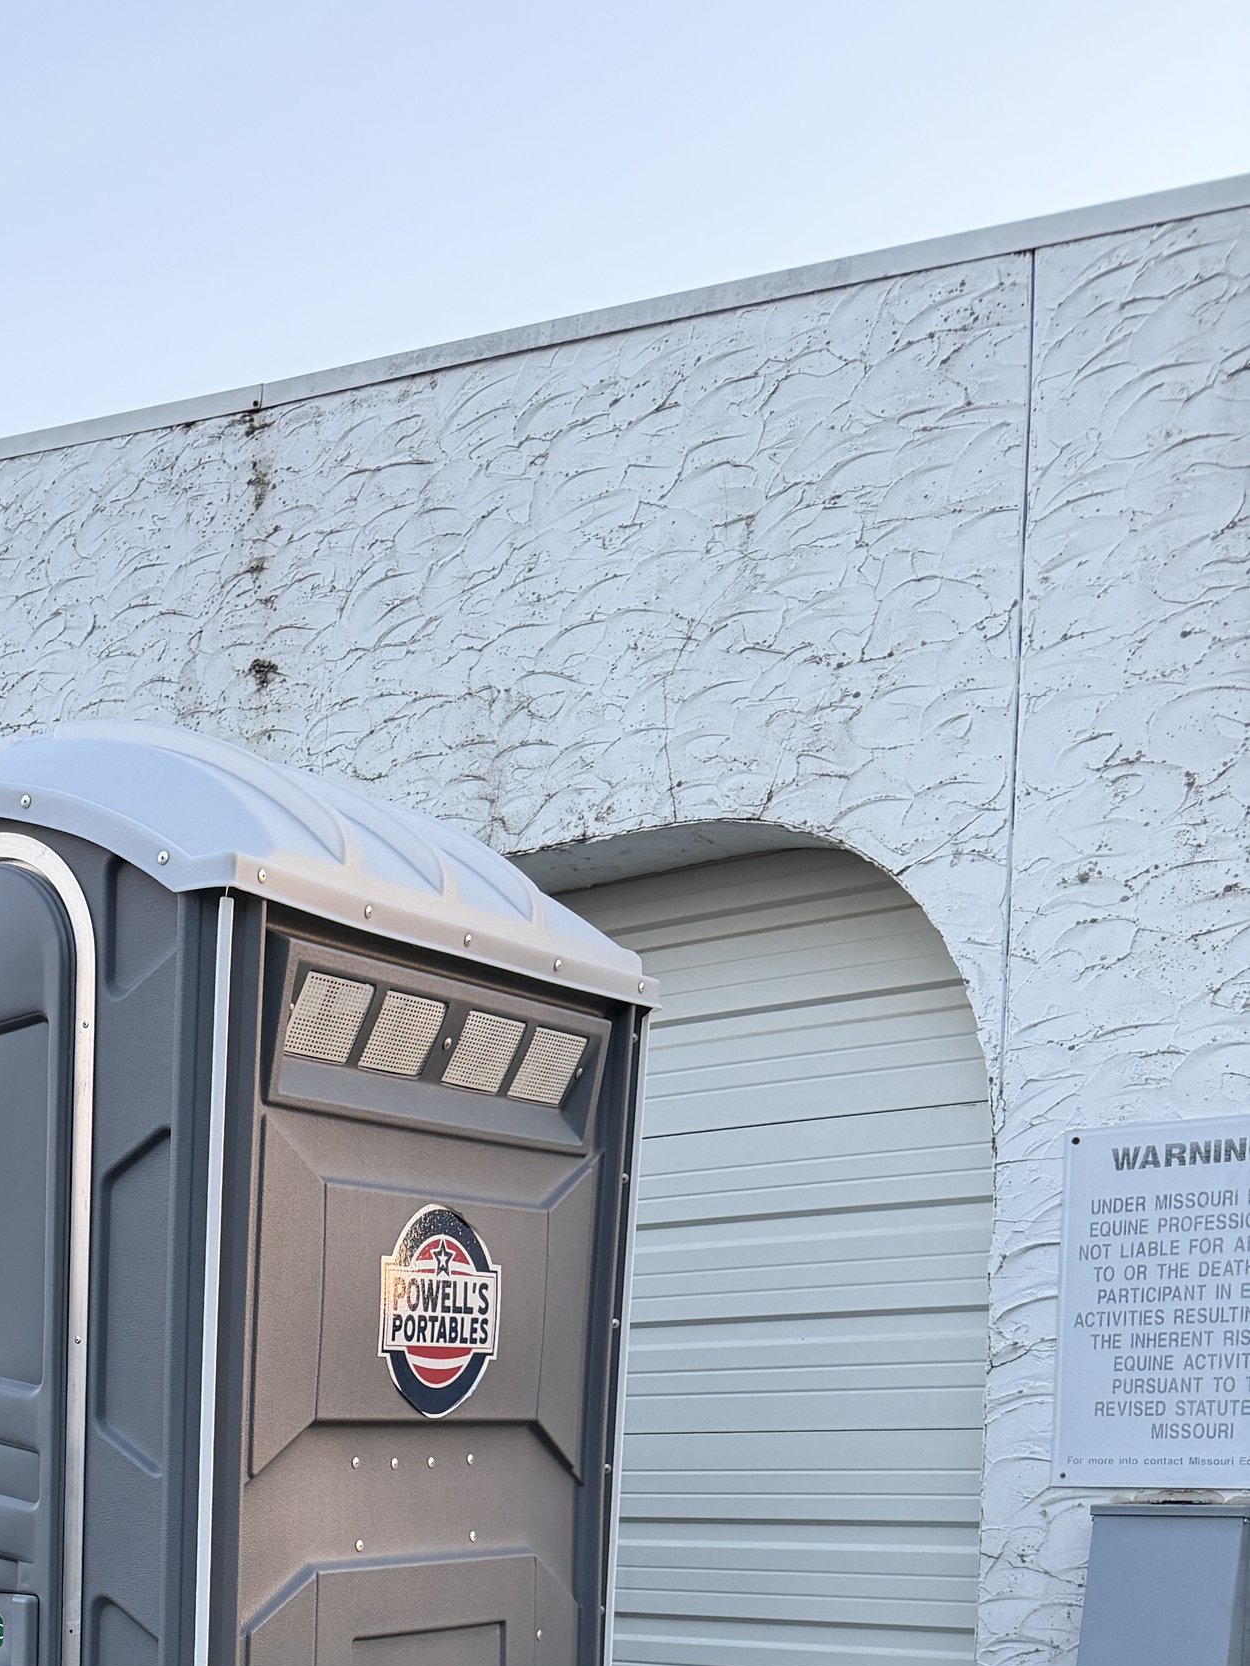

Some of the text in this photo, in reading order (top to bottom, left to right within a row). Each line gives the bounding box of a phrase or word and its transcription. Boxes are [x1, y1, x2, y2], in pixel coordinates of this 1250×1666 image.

[1111, 1137, 1250, 1171] WARNIN
[1091, 1196, 1147, 1215] UNDER
[1155, 1189, 1239, 1211] MISSOURI
[1090, 1218, 1149, 1238] EQUINE
[1078, 1243, 1112, 1261] NOT
[1120, 1239, 1180, 1259] LIABLE
[1189, 1237, 1224, 1255] FOR
[1093, 1266, 1115, 1283] TO
[1124, 1264, 1148, 1281] OR
[1156, 1262, 1190, 1280] THE
[392, 1276, 490, 1316] POWELL'S
[1097, 1284, 1207, 1305] PARTICIPANT
[1215, 1283, 1232, 1300] IN
[1073, 1309, 1165, 1329] ACTIVITIES
[391, 1313, 489, 1346] PORTABLES
[1090, 1333, 1122, 1350] THE
[1130, 1330, 1214, 1349] INHERENT
[1113, 1354, 1175, 1372] EQUINE
[1112, 1377, 1204, 1394] PURSUANT
[1213, 1376, 1236, 1393] TO
[1094, 1400, 1166, 1417] REVISED
[1151, 1422, 1235, 1440] MISSOURI
[1067, 1456, 1084, 1465] For
[1088, 1457, 1114, 1466] more
[1119, 1456, 1139, 1466] info
[1144, 1456, 1184, 1466] contact
[1189, 1456, 1235, 1466] Missouri
